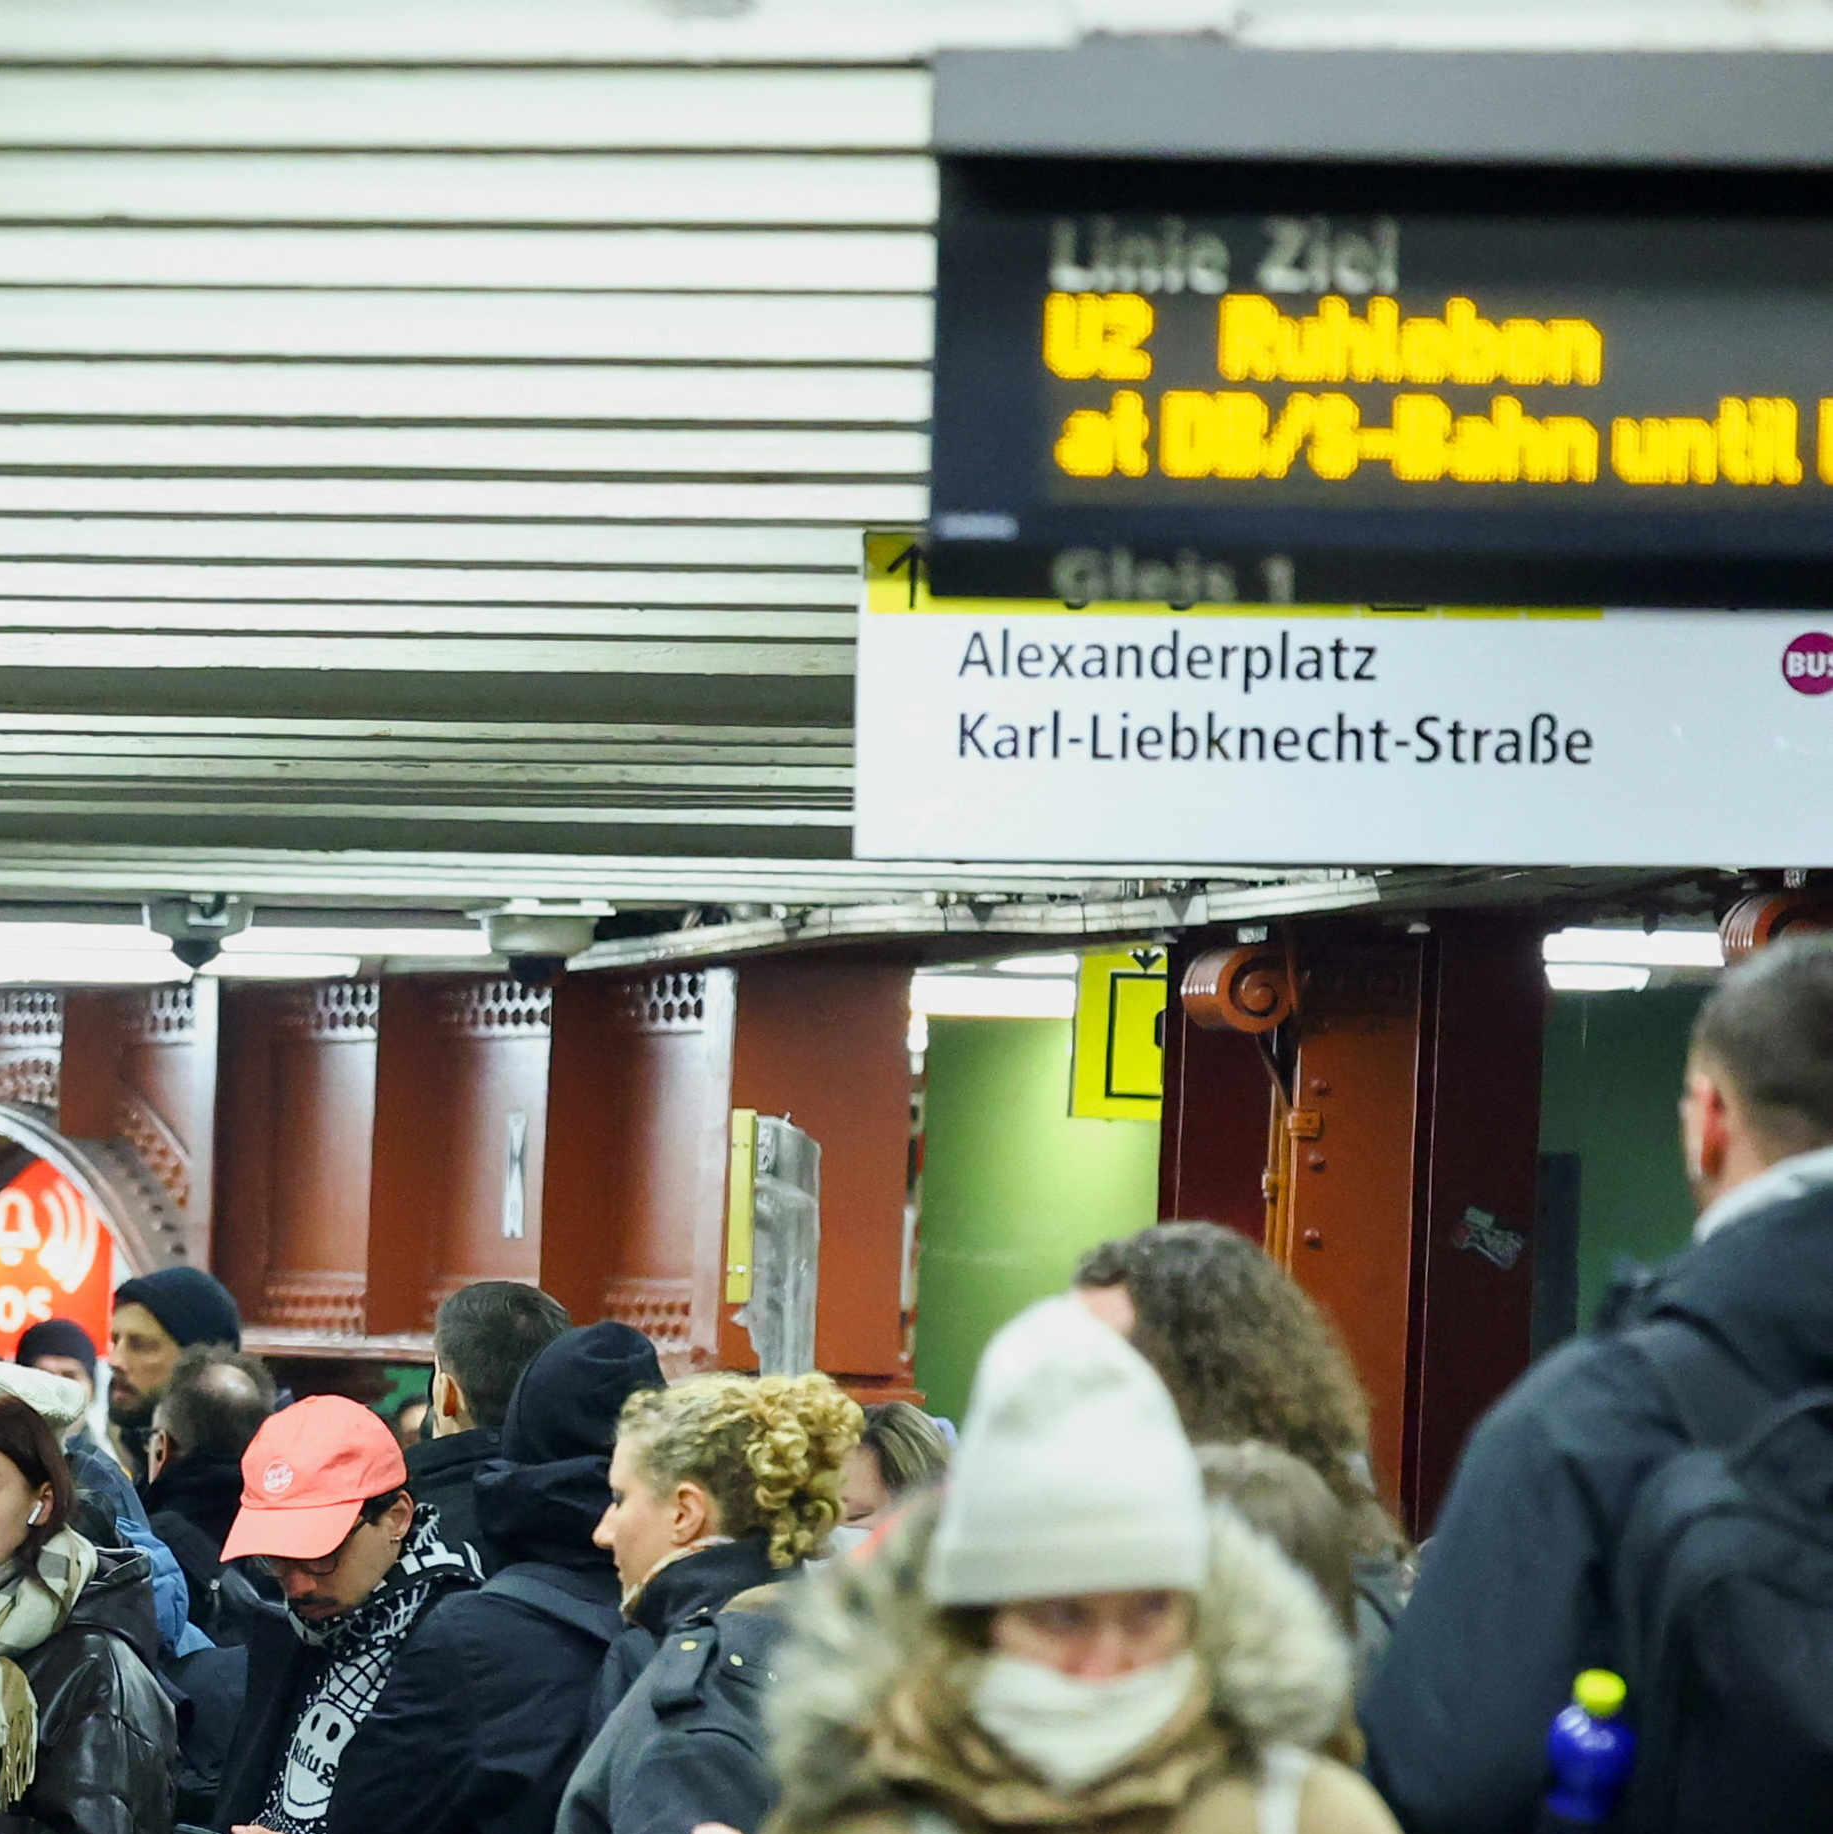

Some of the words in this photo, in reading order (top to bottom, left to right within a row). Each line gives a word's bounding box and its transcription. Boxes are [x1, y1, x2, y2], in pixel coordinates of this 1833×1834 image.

[1049, 216, 1231, 293] Linie
[1259, 216, 1400, 295] Ziel
[1044, 292, 1155, 381] U2
[1218, 294, 1604, 387] Ruhleben
[1159, 390, 1600, 485] DB/S-Bahn
[1051, 547, 1238, 602] Gleis
[1261, 554, 1296, 604] 1
[958, 629, 1378, 693] Alexanderplatz
[958, 711, 1594, 765] Karl-Liebknecht-Straße
